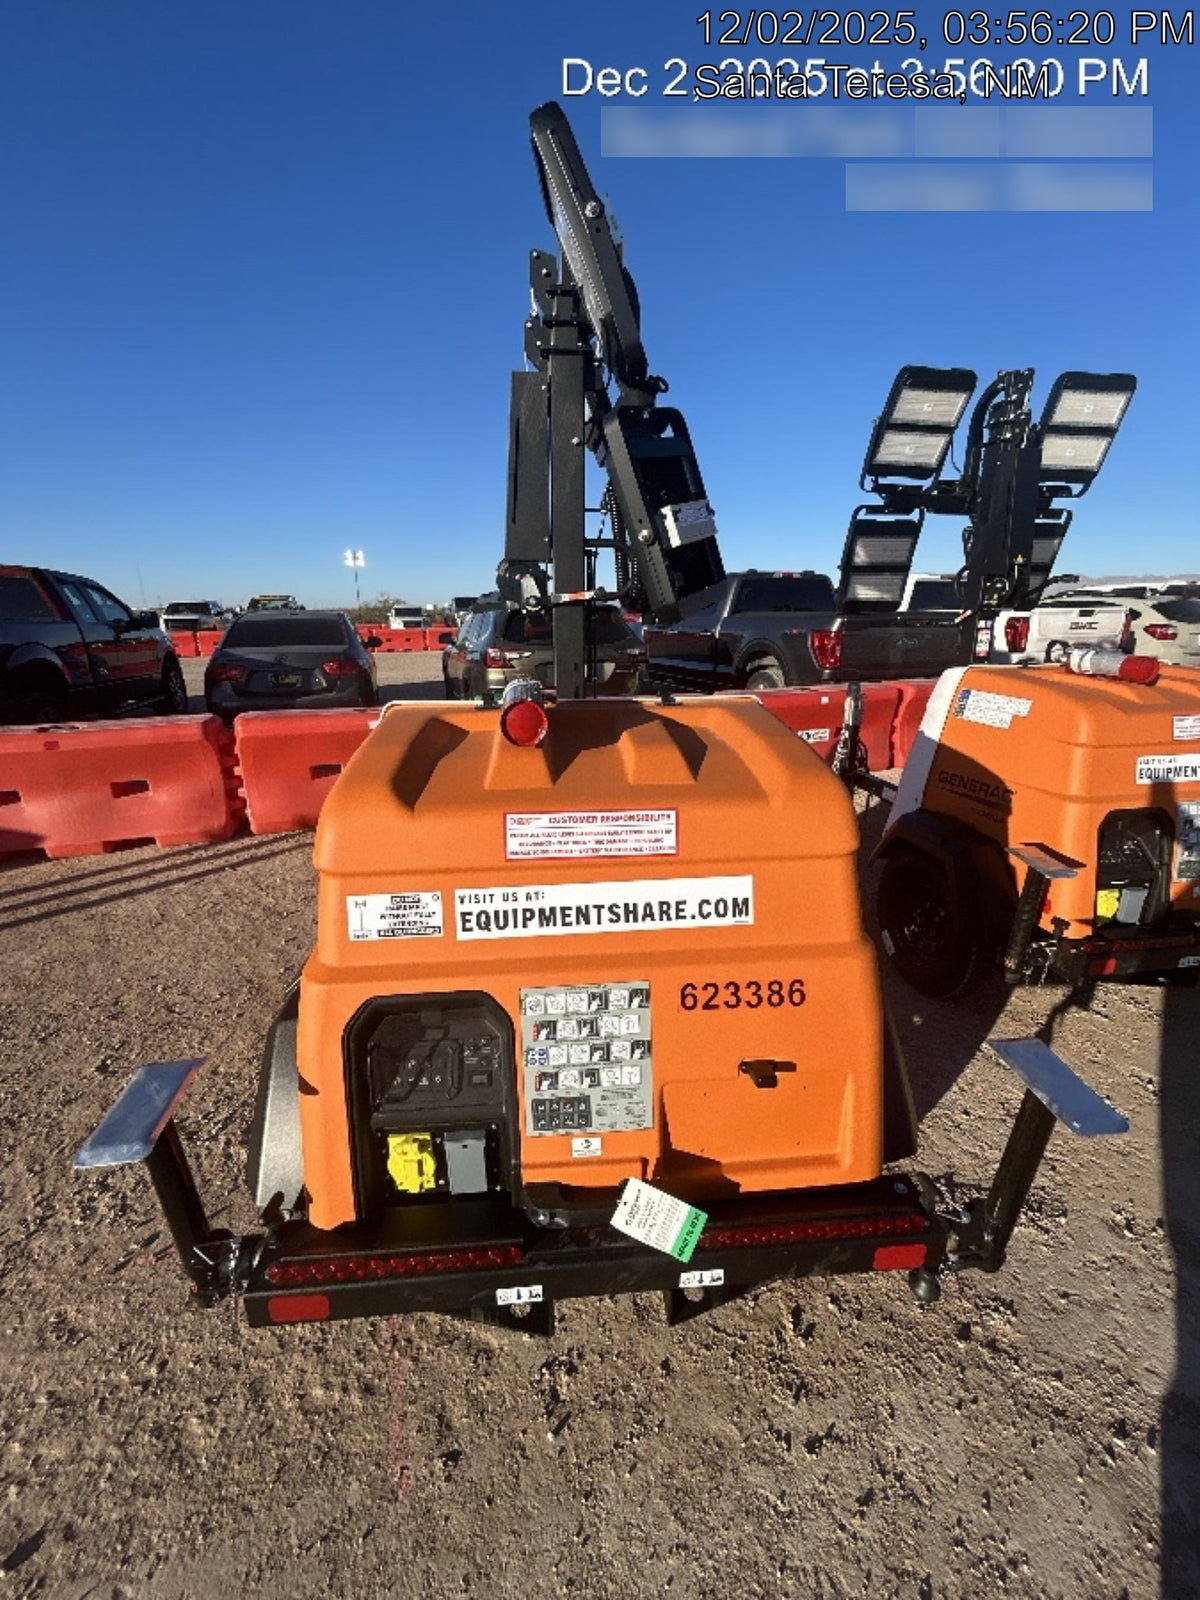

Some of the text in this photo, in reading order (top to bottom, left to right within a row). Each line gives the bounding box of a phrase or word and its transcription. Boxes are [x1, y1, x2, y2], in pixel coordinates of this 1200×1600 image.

[1069, 621, 1099, 630] GMC
[1139, 766, 1200, 779] EQUIPMEN
[548, 815, 598, 825] CUSTOMER
[458, 891, 545, 905] VISIT US AT:
[460, 897, 750, 932] EQUIPMENTSHARE.COM
[680, 979, 806, 1011] 623386
